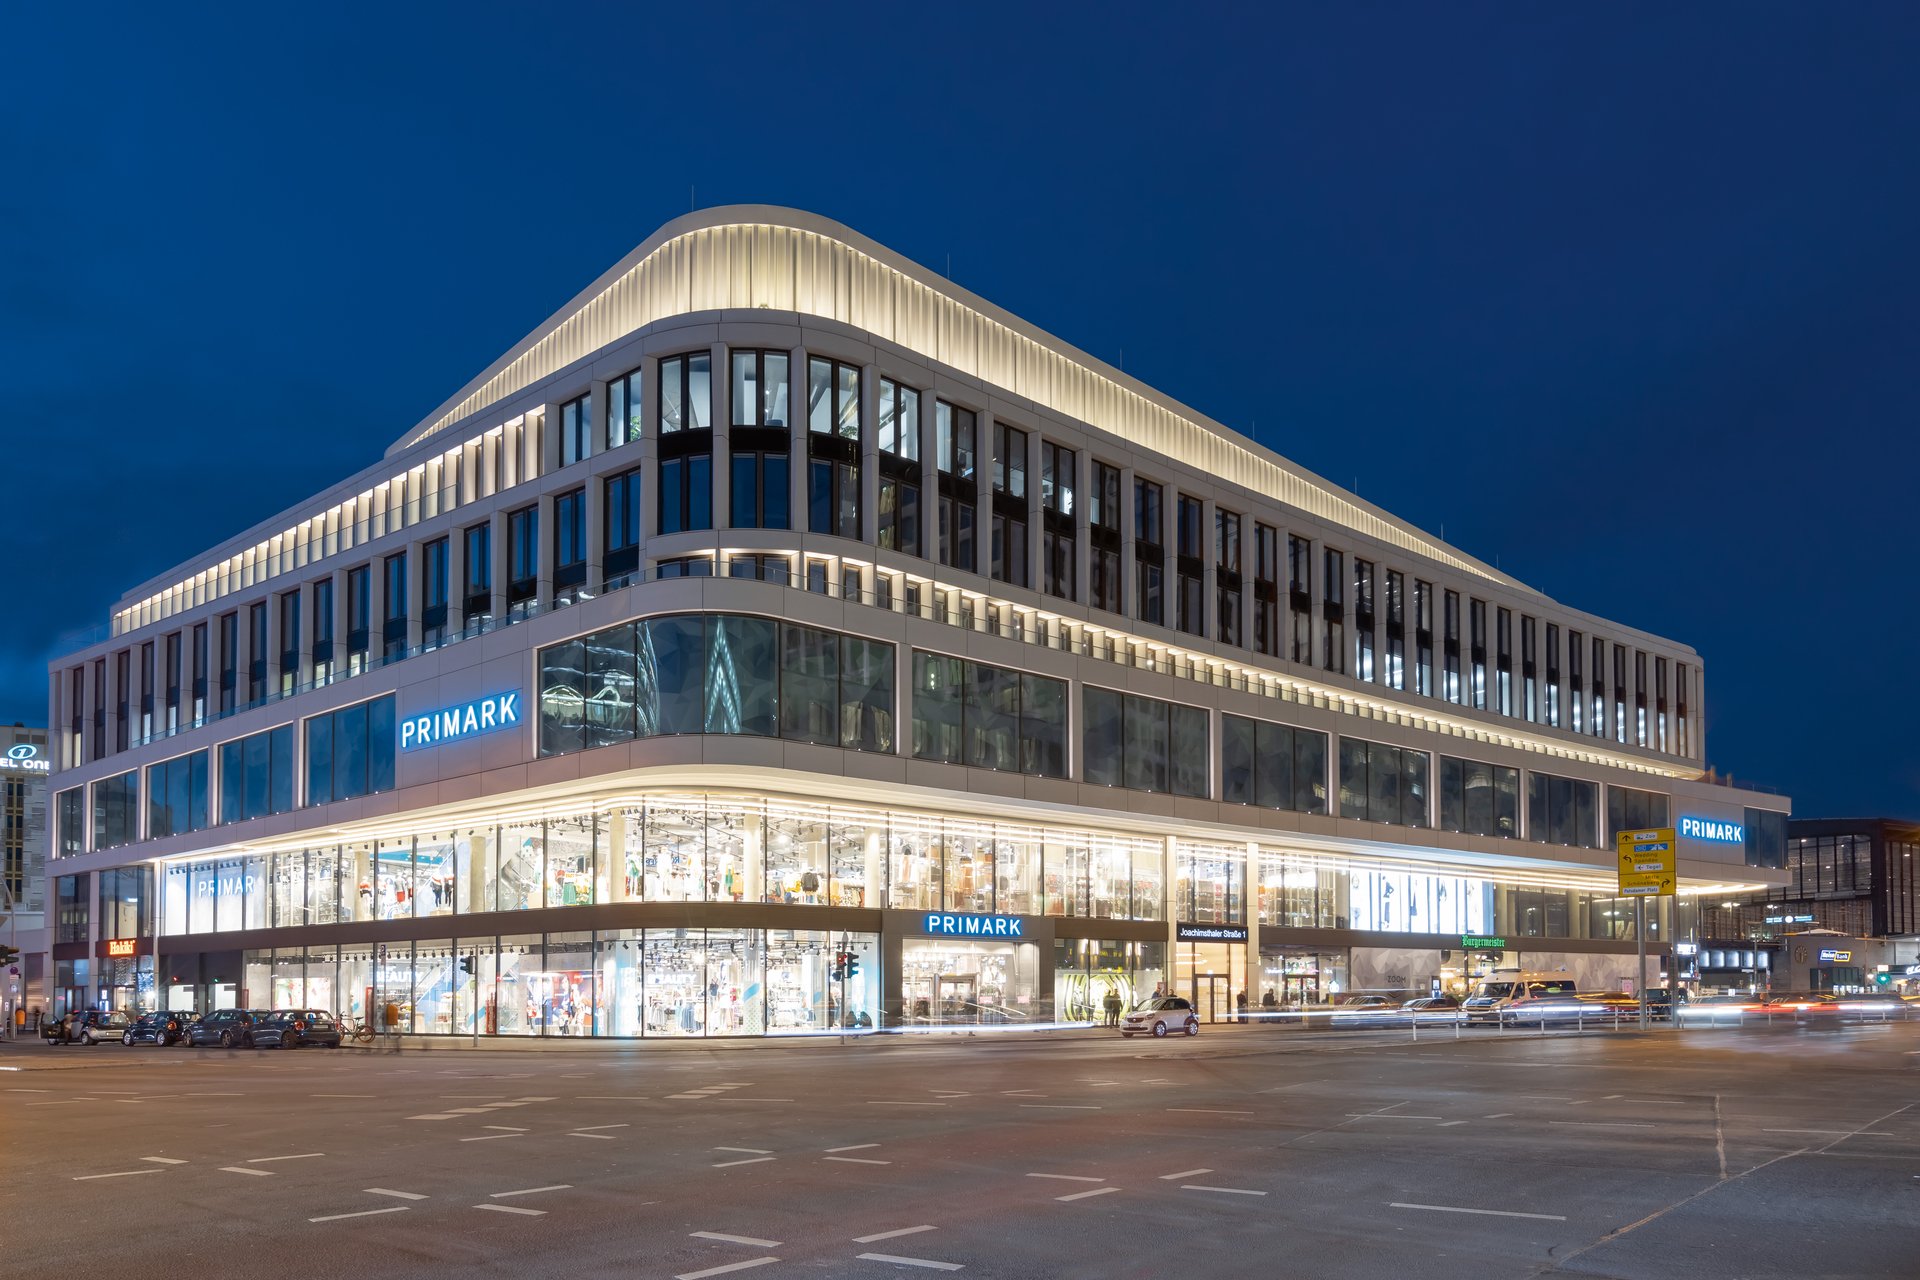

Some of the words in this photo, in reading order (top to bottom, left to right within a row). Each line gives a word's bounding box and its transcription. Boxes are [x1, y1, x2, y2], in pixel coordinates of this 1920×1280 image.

[402, 694, 516, 748] PRIMARK
[1682, 818, 1742, 842] PRIMARK
[928, 915, 1021, 935] PRIMARK
[1180, 928, 1222, 938] Joachimsthaler
[1223, 930, 1242, 938] Straße
[1387, 975, 1407, 983] ZOOM
